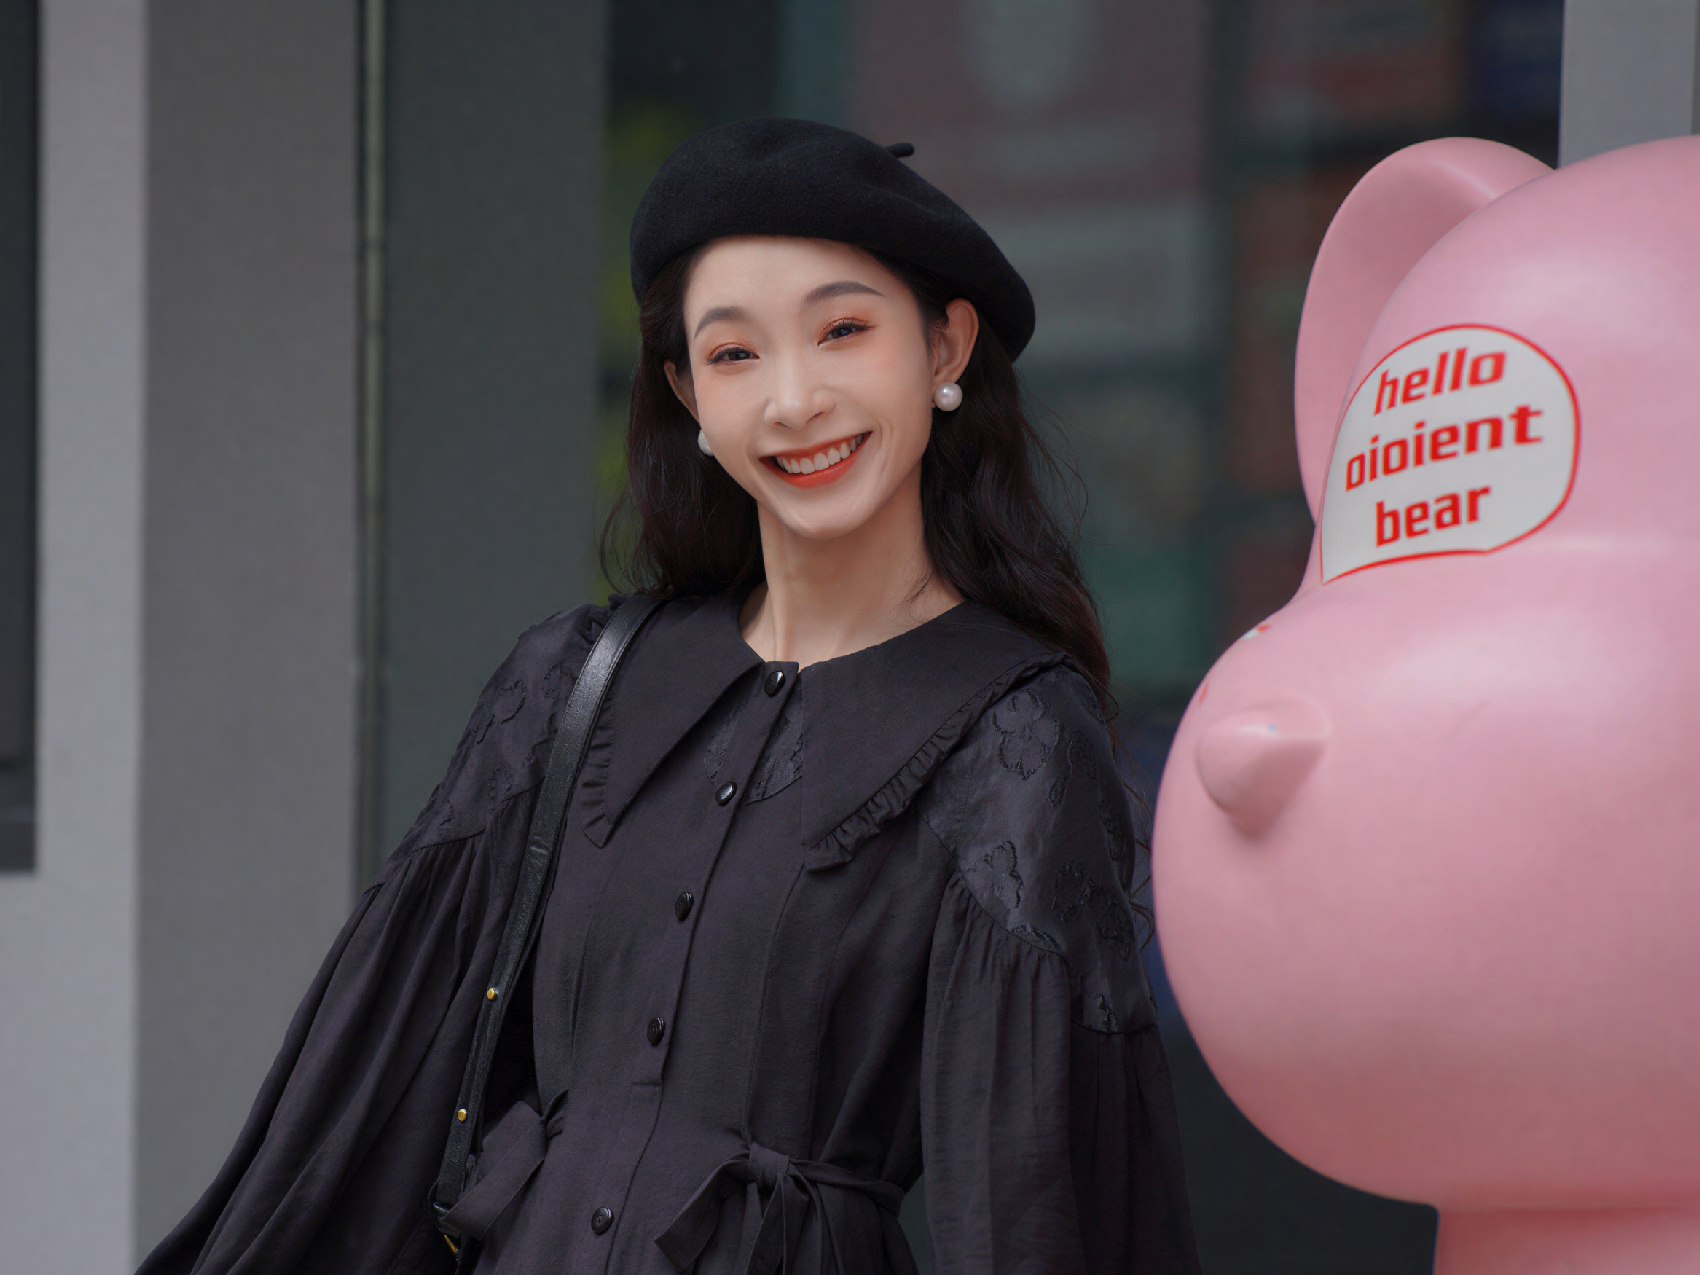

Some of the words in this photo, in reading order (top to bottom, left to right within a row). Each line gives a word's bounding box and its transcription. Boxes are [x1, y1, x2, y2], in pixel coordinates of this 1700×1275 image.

[1374, 347, 1506, 416] hello
[1346, 405, 1543, 492] oioient
[1376, 485, 1491, 548] bear
